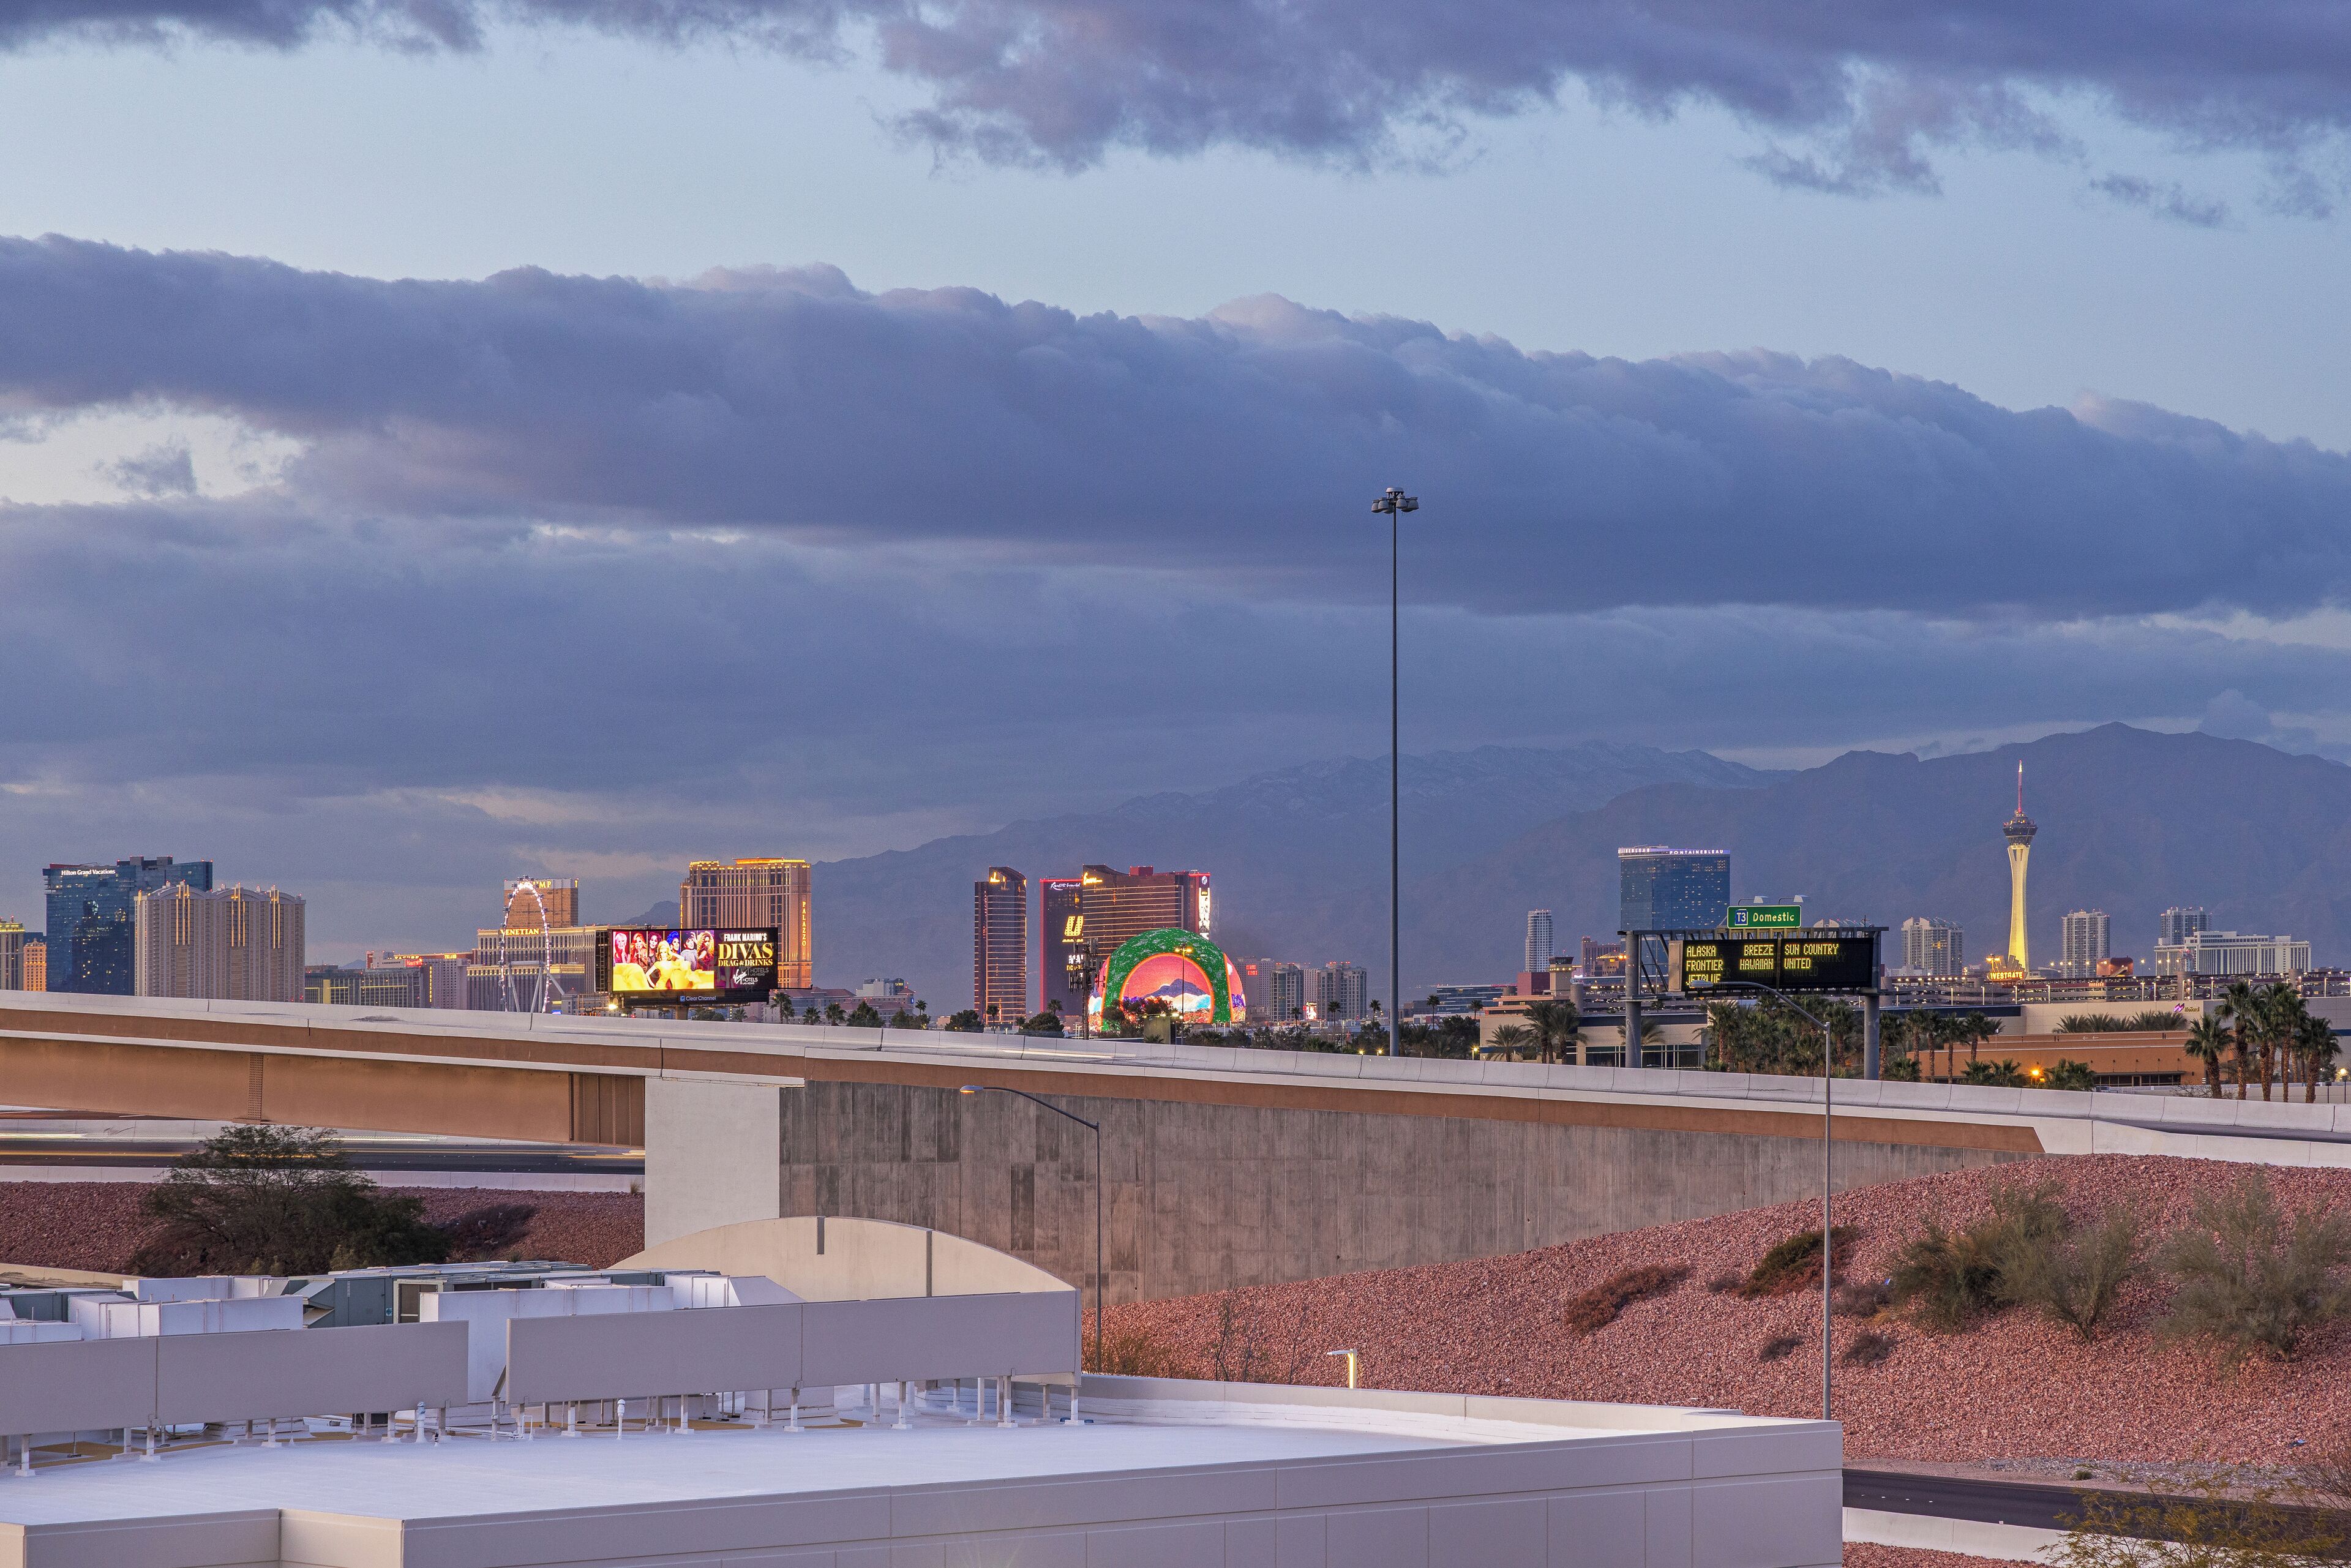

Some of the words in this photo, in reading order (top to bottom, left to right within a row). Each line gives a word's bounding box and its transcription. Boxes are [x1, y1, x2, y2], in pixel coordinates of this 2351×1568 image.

[1736, 912, 1746, 922] T3
[1753, 912, 1794, 922] Domestic
[724, 933, 741, 942] FRANK
[741, 932, 767, 941] MARINO'S
[718, 943, 773, 959] DIVAS
[1686, 946, 1716, 957] ALASKA
[1744, 944, 1774, 956] BREEZE
[1784, 944, 1799, 955] SUN
[1803, 943, 1839, 955] COUNTRY
[1685, 959, 1723, 971] FRONTIER
[1739, 958, 1774, 970] HAWAIIAN
[1784, 958, 1811, 969] UNITED
